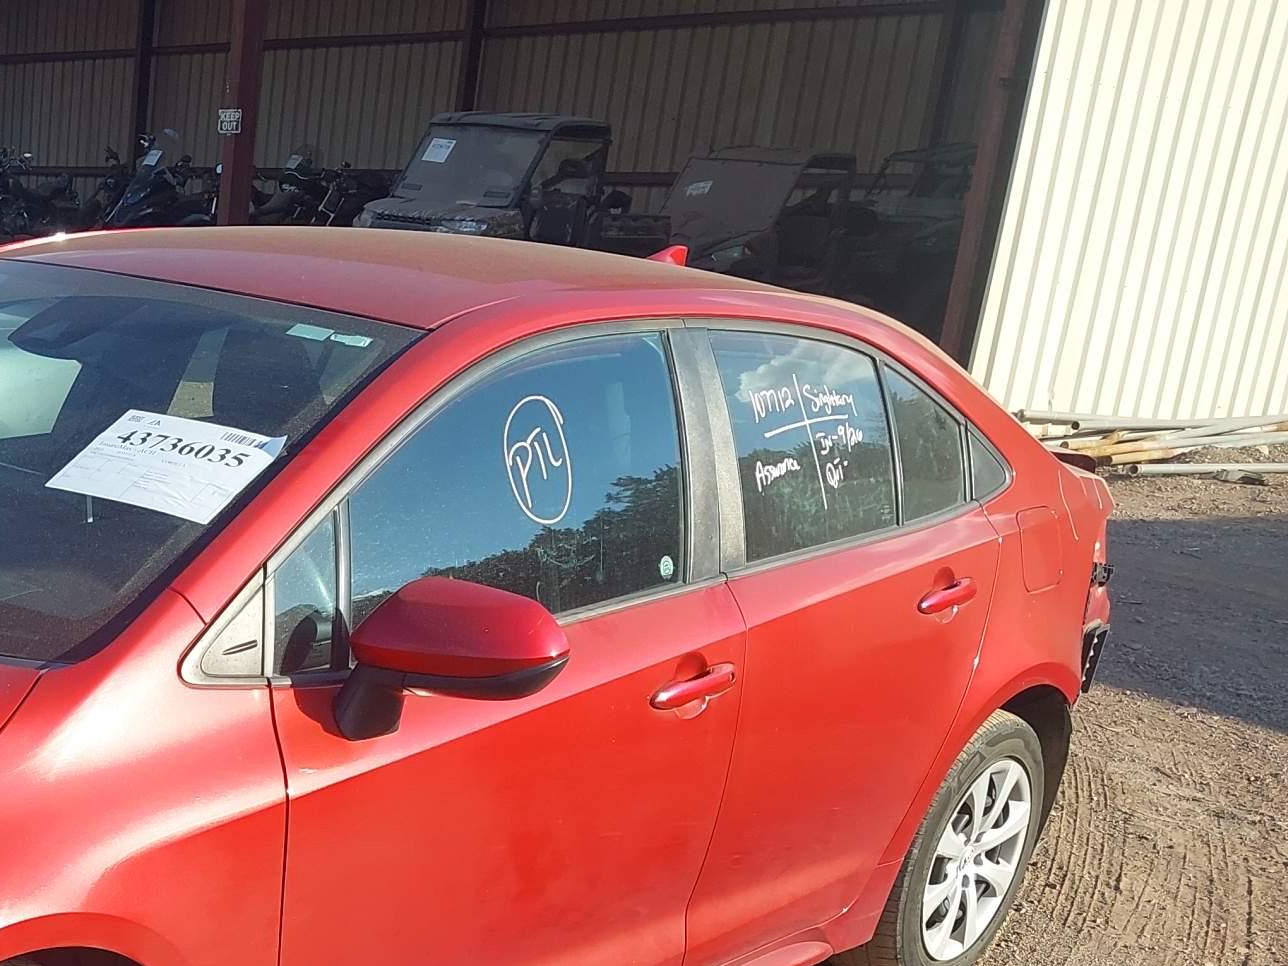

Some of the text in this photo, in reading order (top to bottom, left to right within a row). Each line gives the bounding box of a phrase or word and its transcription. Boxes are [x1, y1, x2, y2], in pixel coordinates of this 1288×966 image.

[220, 112, 240, 121] KEEP
[222, 121, 237, 131] OUT
[117, 429, 252, 468] 43736035
